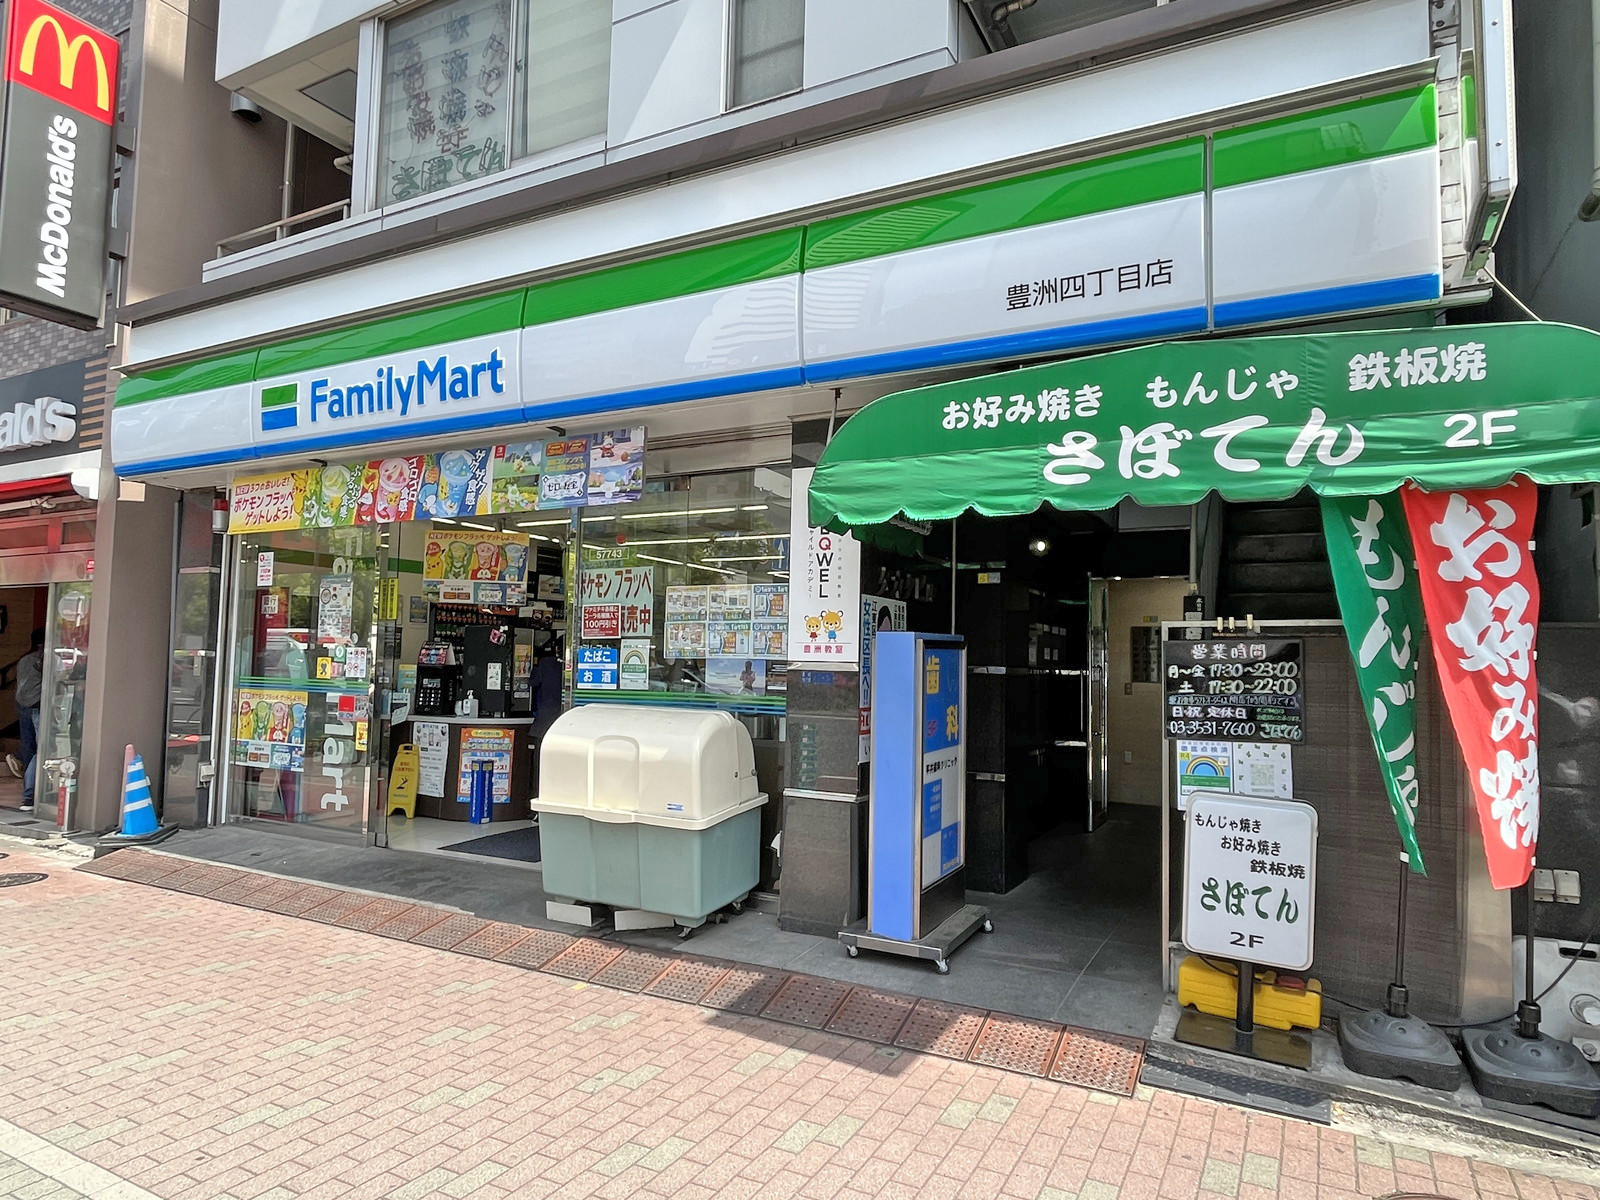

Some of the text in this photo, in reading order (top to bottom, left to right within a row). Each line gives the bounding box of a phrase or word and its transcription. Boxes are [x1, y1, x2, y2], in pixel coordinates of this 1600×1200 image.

[36, 114, 78, 298] McDonald's
[1006, 258, 1174, 311] 豊洲四丁目店
[310, 347, 506, 423] FamilyMart
[942, 341, 1488, 431] お好み焼き もんじゃ 鉄板焼
[1042, 408, 1519, 485] さぼてん 2F
[596, 550, 623, 559] 57743
[583, 651, 612, 663] たばこ
[1190, 643, 1267, 660] 営業時間
[1178, 680, 1195, 694] 土
[1206, 706, 1248, 720] 定休日
[1194, 812, 1262, 833] もんじゃ焼き
[1220, 836, 1282, 856] お好み焼き
[1250, 859, 1306, 879] 鉄板焼
[1200, 876, 1299, 925] さぼてん
[1229, 931, 1265, 949] 2F
